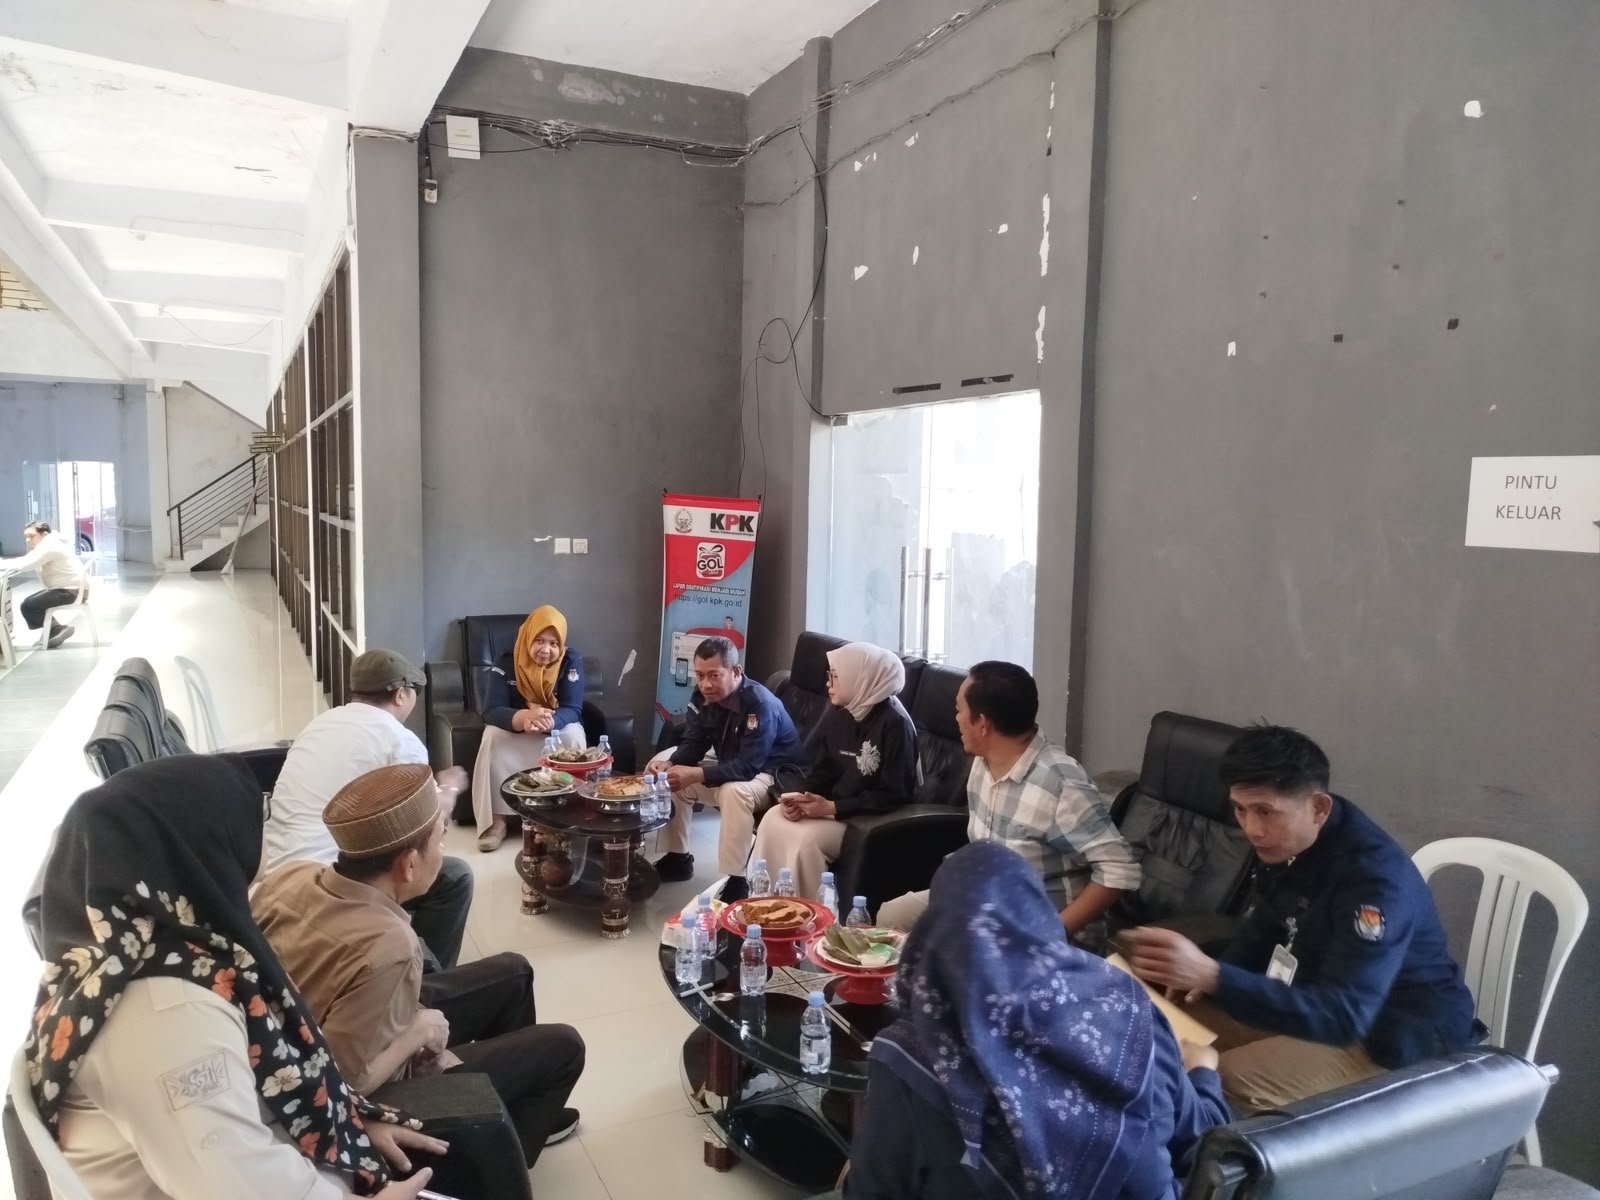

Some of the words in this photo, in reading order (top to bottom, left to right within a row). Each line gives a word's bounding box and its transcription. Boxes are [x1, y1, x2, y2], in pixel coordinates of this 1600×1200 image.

[1505, 475, 1557, 489] PINTU
[1496, 504, 1561, 520] KELUAR
[710, 513, 755, 533] KPK
[697, 559, 724, 571] GOL
